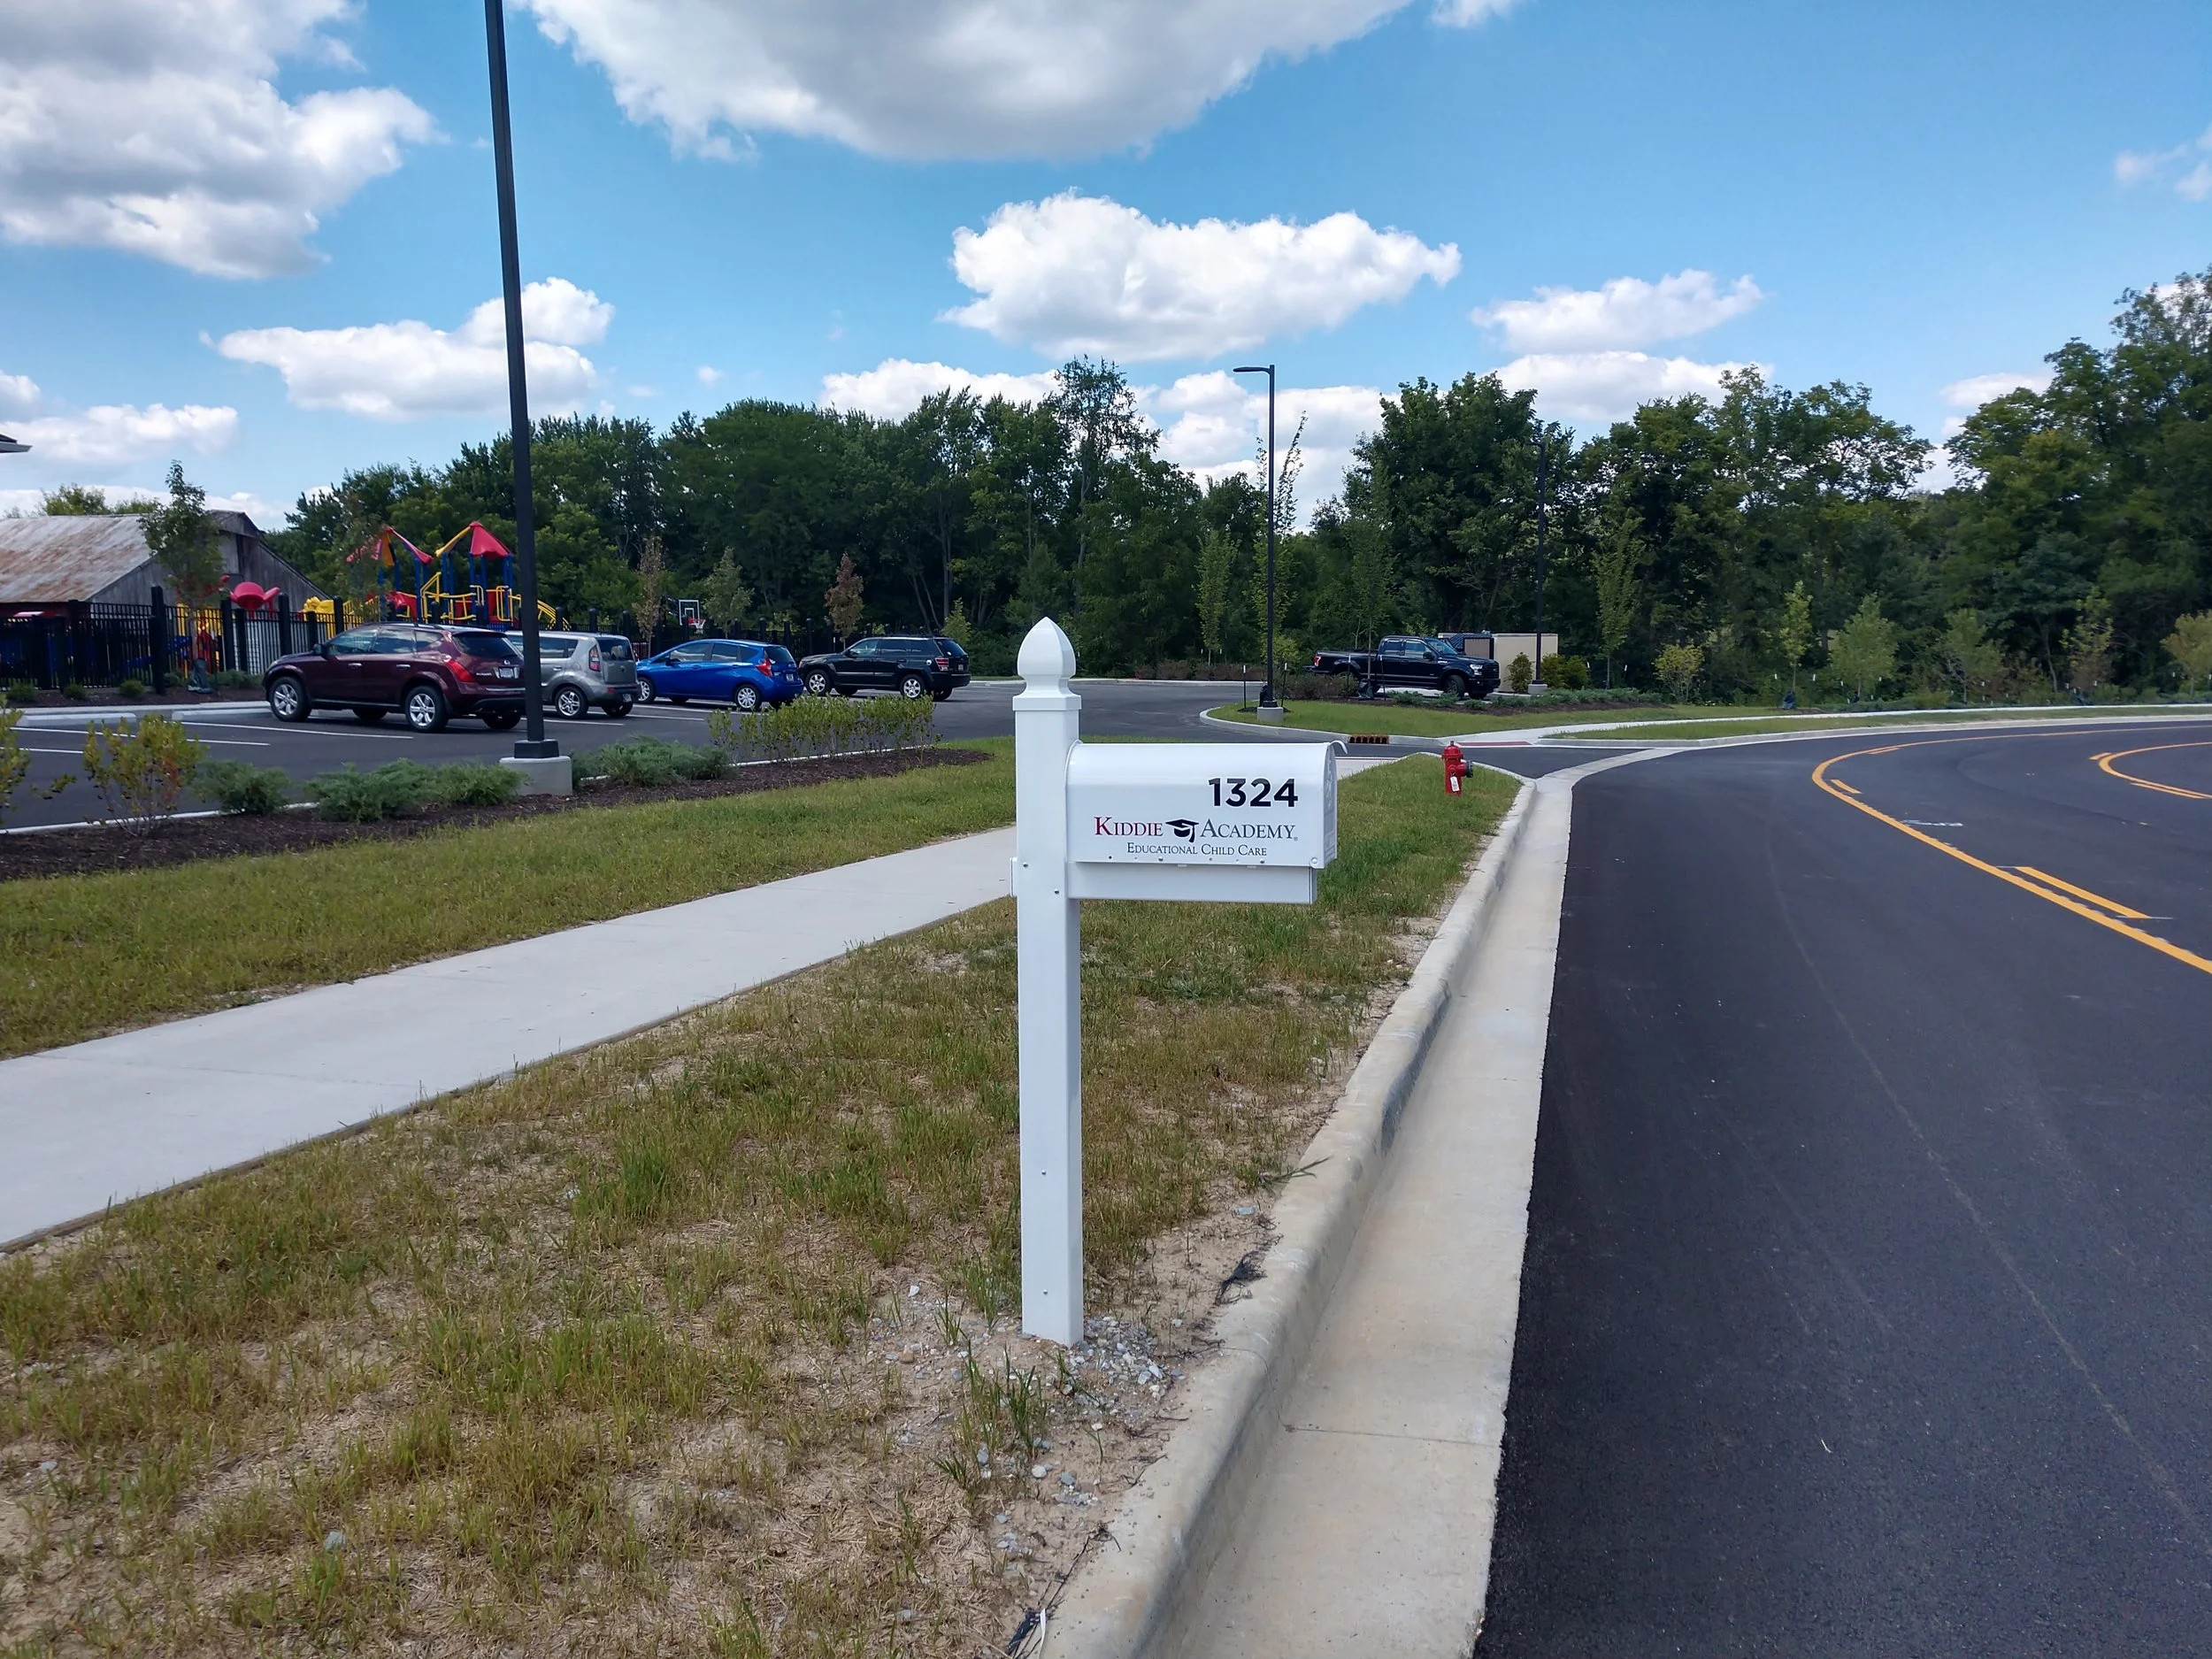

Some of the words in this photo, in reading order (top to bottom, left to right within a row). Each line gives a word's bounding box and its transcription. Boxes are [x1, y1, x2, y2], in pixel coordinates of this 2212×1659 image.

[1209, 778, 1299, 808] 1324
[1094, 816, 1164, 837] KIDDIE
[1127, 841, 1198, 855] EDUCATIONAL
[1201, 843, 1235, 856] CHILD
[1238, 844, 1267, 856] CARE
